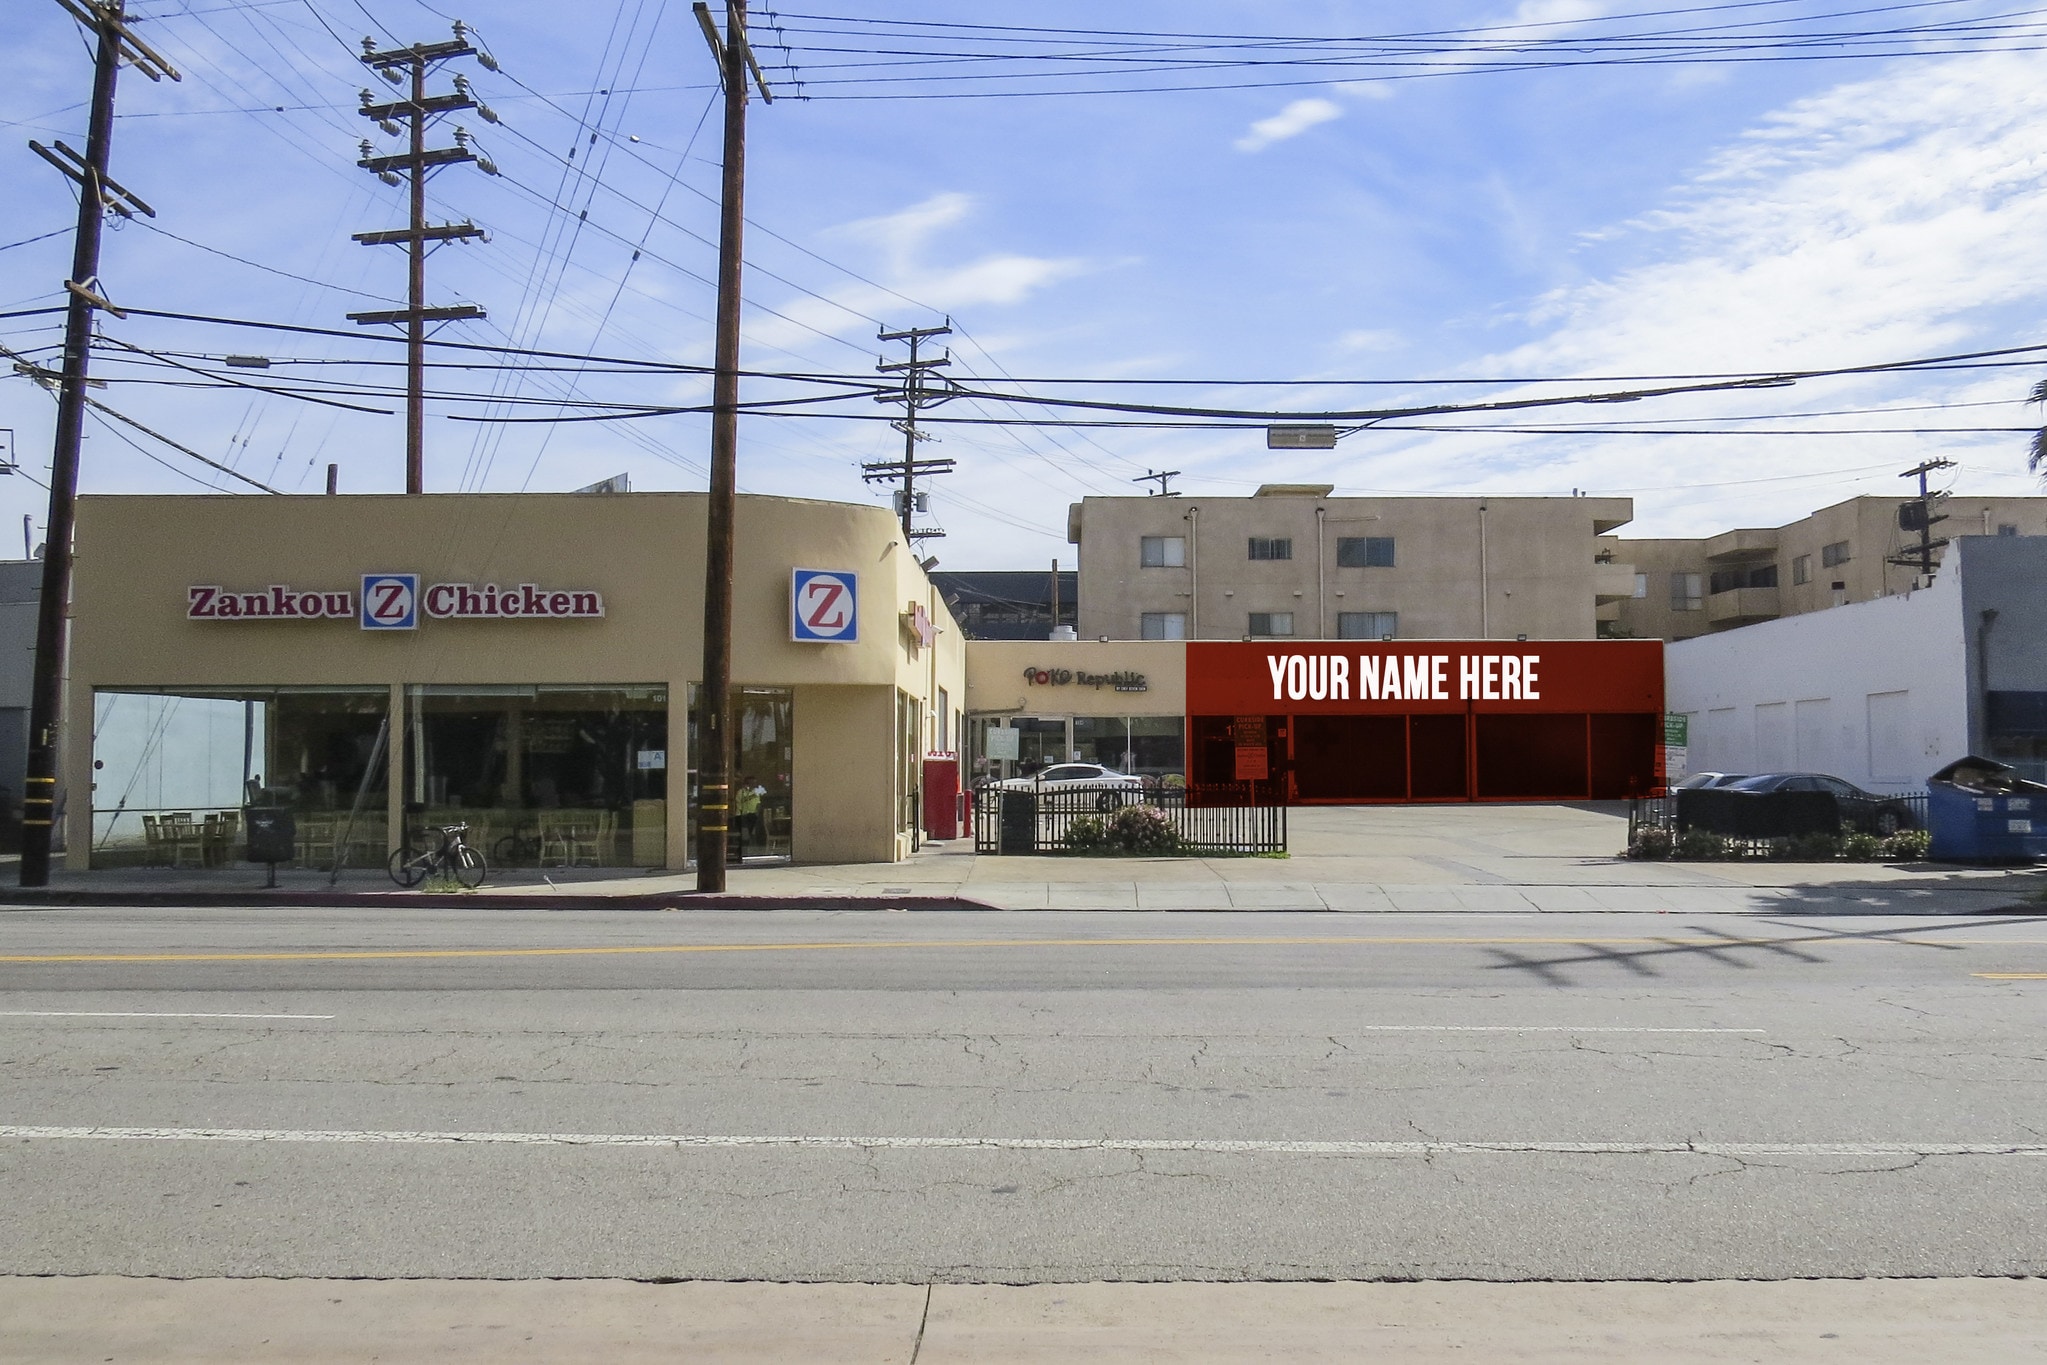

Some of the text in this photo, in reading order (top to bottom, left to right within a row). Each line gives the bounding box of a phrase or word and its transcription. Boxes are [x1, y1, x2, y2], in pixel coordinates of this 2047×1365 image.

[188, 584, 600, 618] Zankou Z Chicken
[807, 583, 844, 628] Z
[1076, 671, 1147, 690] Republic
